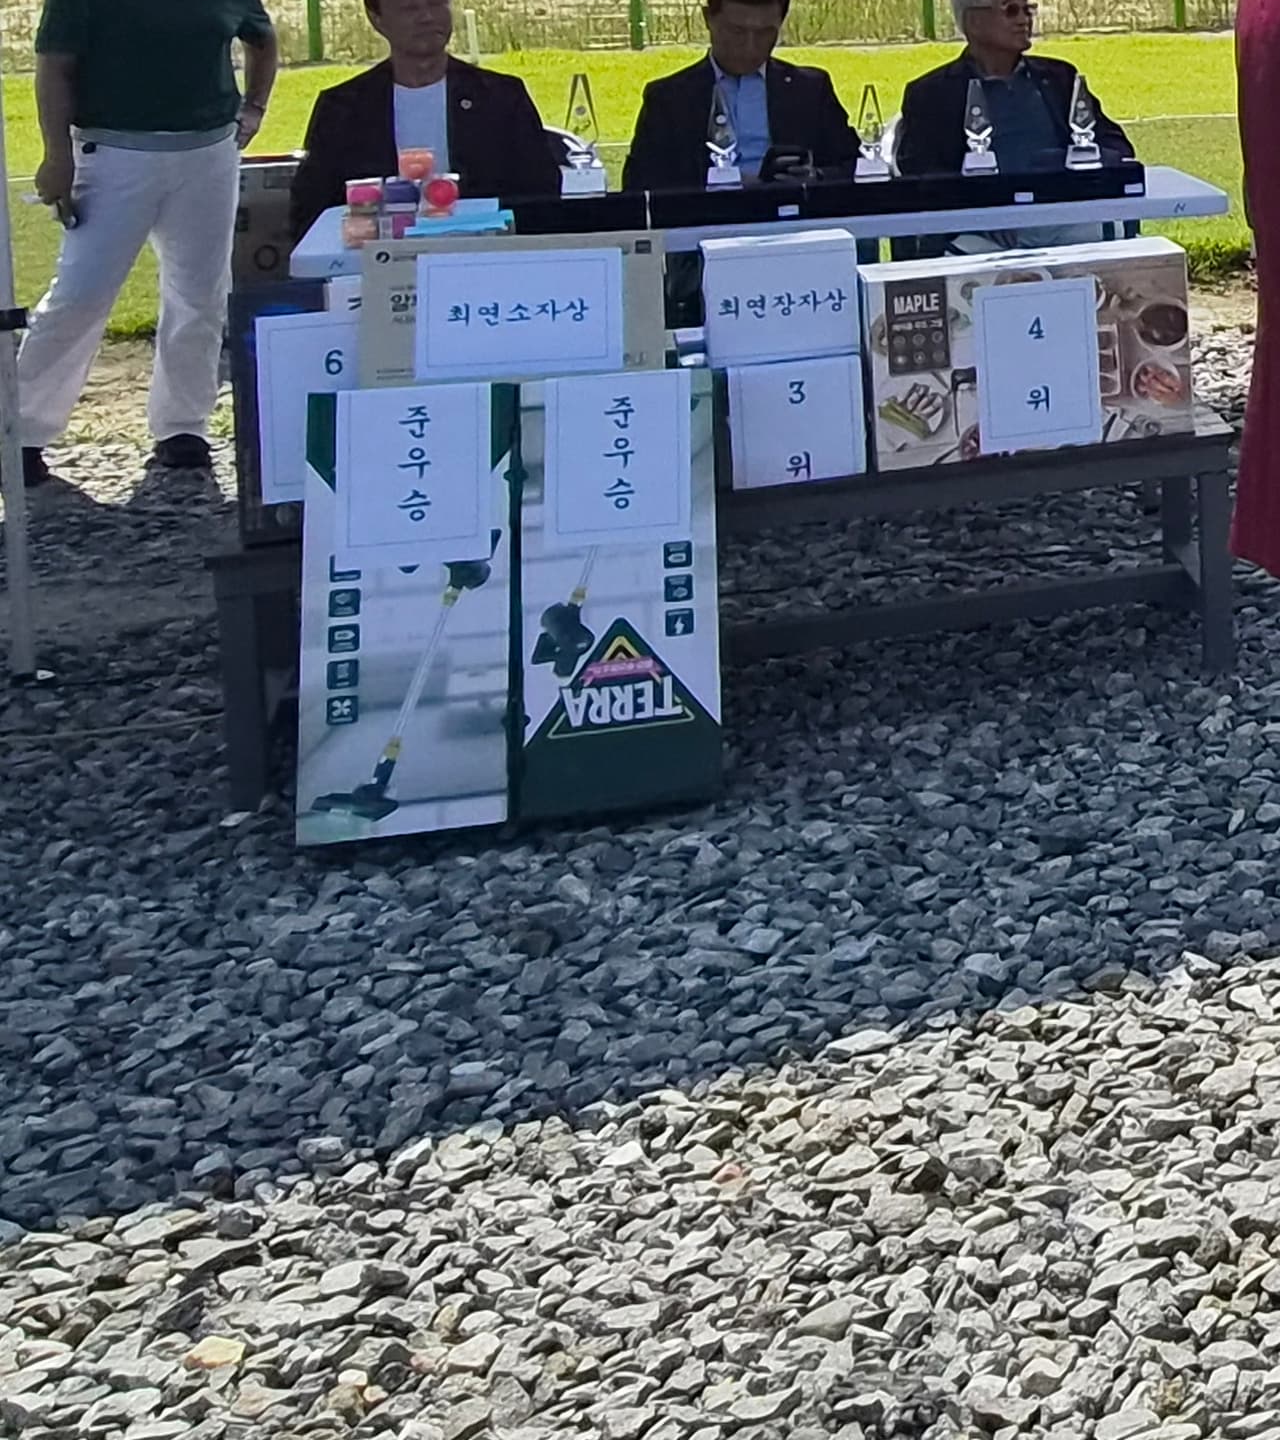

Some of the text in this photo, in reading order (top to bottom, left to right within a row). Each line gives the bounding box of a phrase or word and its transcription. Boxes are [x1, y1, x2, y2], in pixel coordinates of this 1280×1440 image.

[448, 296, 590, 327] 최연소자상
[717, 286, 849, 320] 최연장자상
[892, 291, 941, 316] MAPLE
[324, 348, 344, 376] 6
[1026, 316, 1051, 414] 4 위
[602, 395, 636, 511] 준우승
[785, 380, 812, 479] 3 위
[397, 404, 433, 523] 준우승
[562, 674, 684, 729] TERRA
